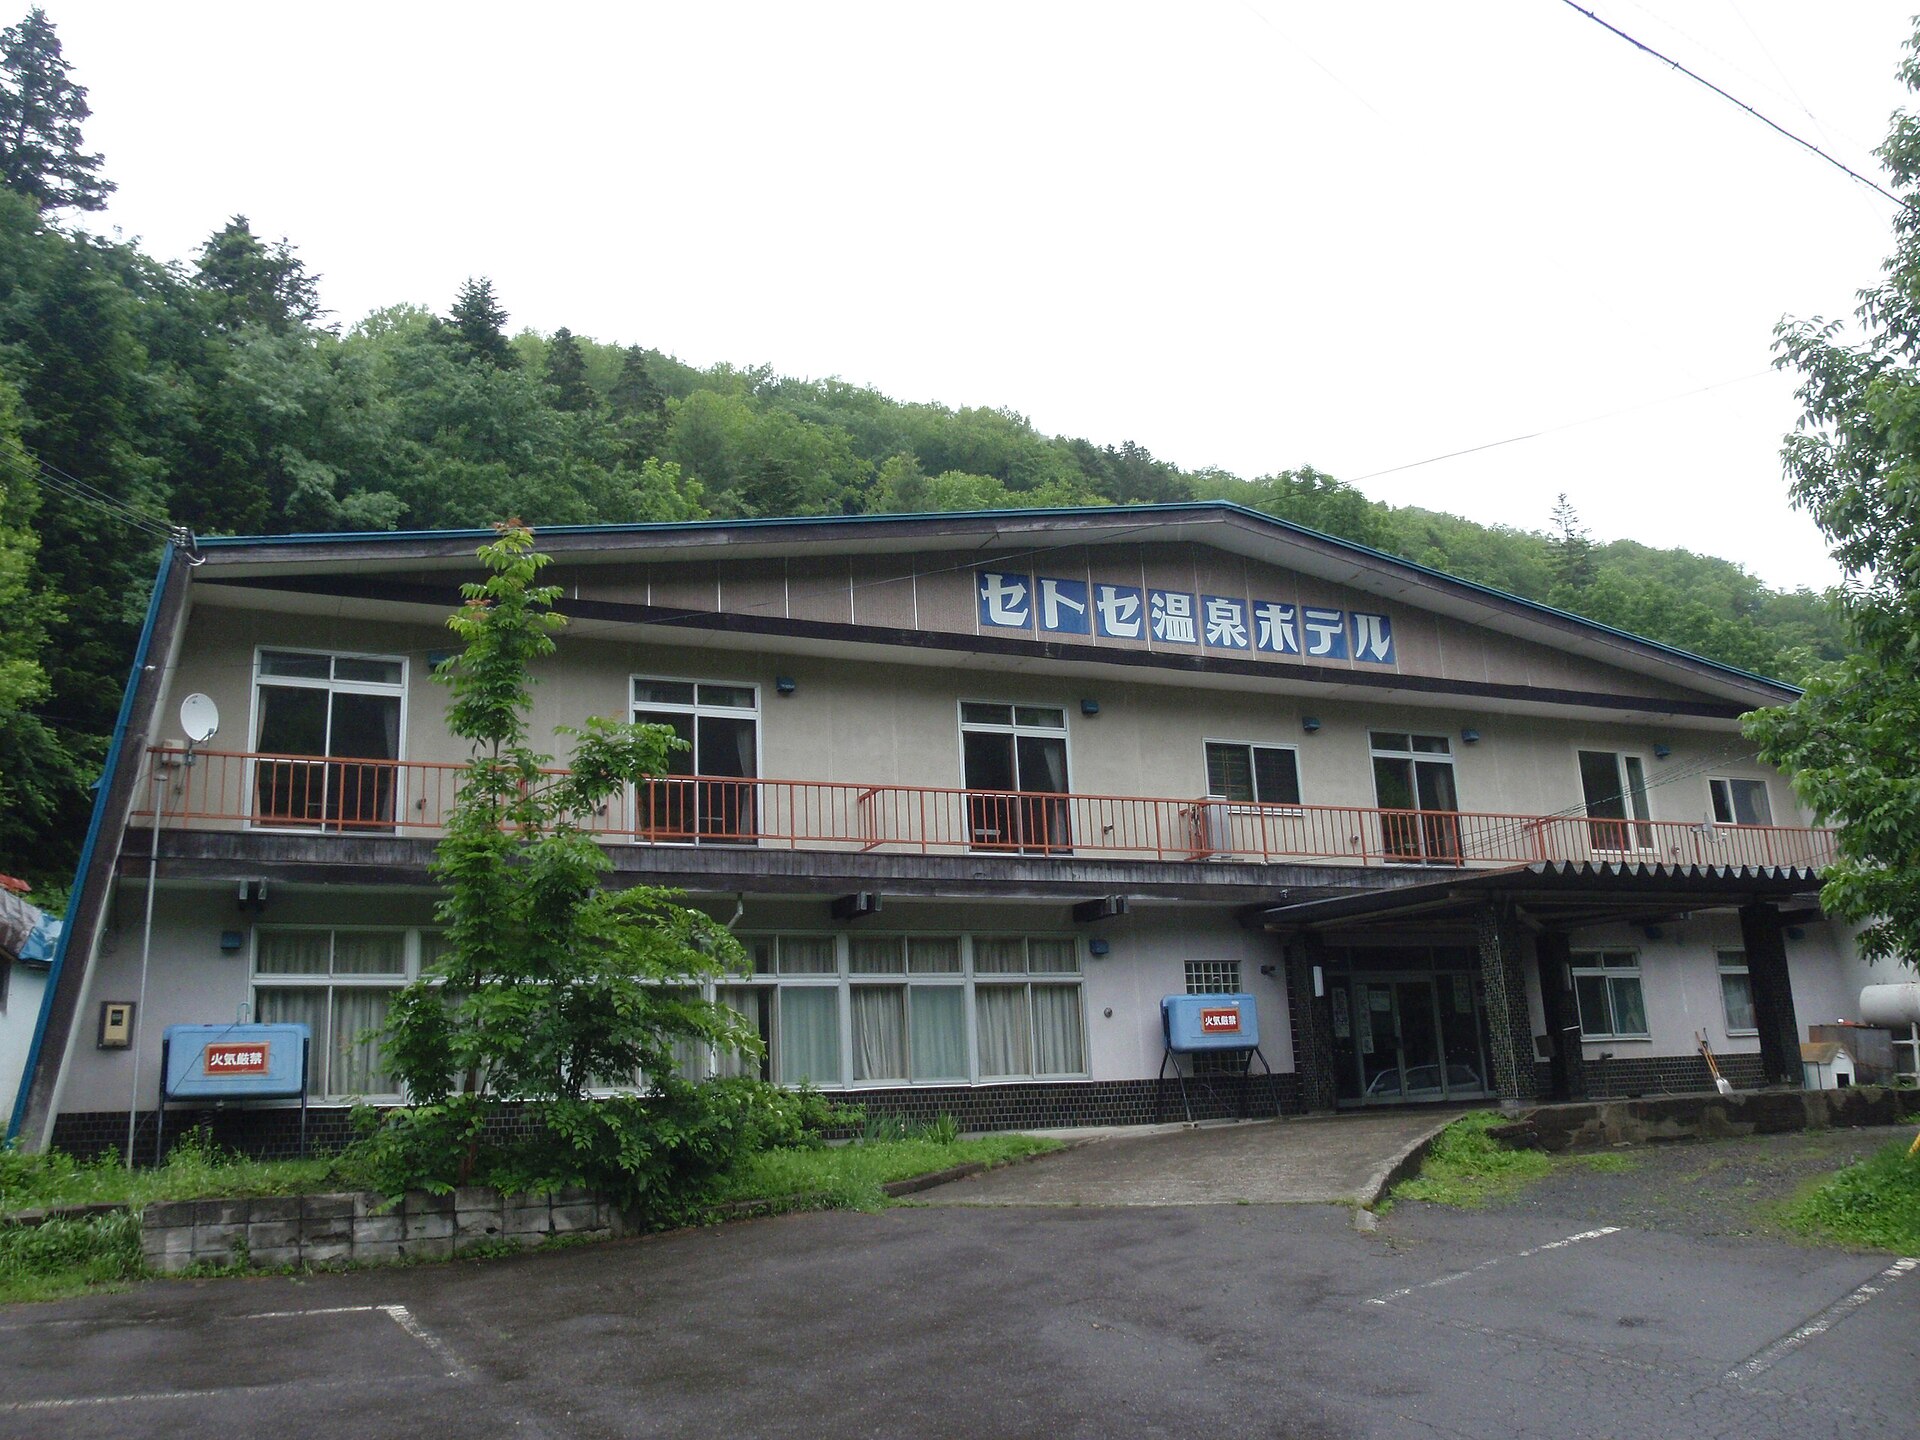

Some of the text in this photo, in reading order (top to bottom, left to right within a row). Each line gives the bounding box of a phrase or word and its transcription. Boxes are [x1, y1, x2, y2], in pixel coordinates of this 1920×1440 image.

[981, 574, 1391, 661] セトセ温泉ホテル
[210, 1052, 262, 1066] 火気厳禁
